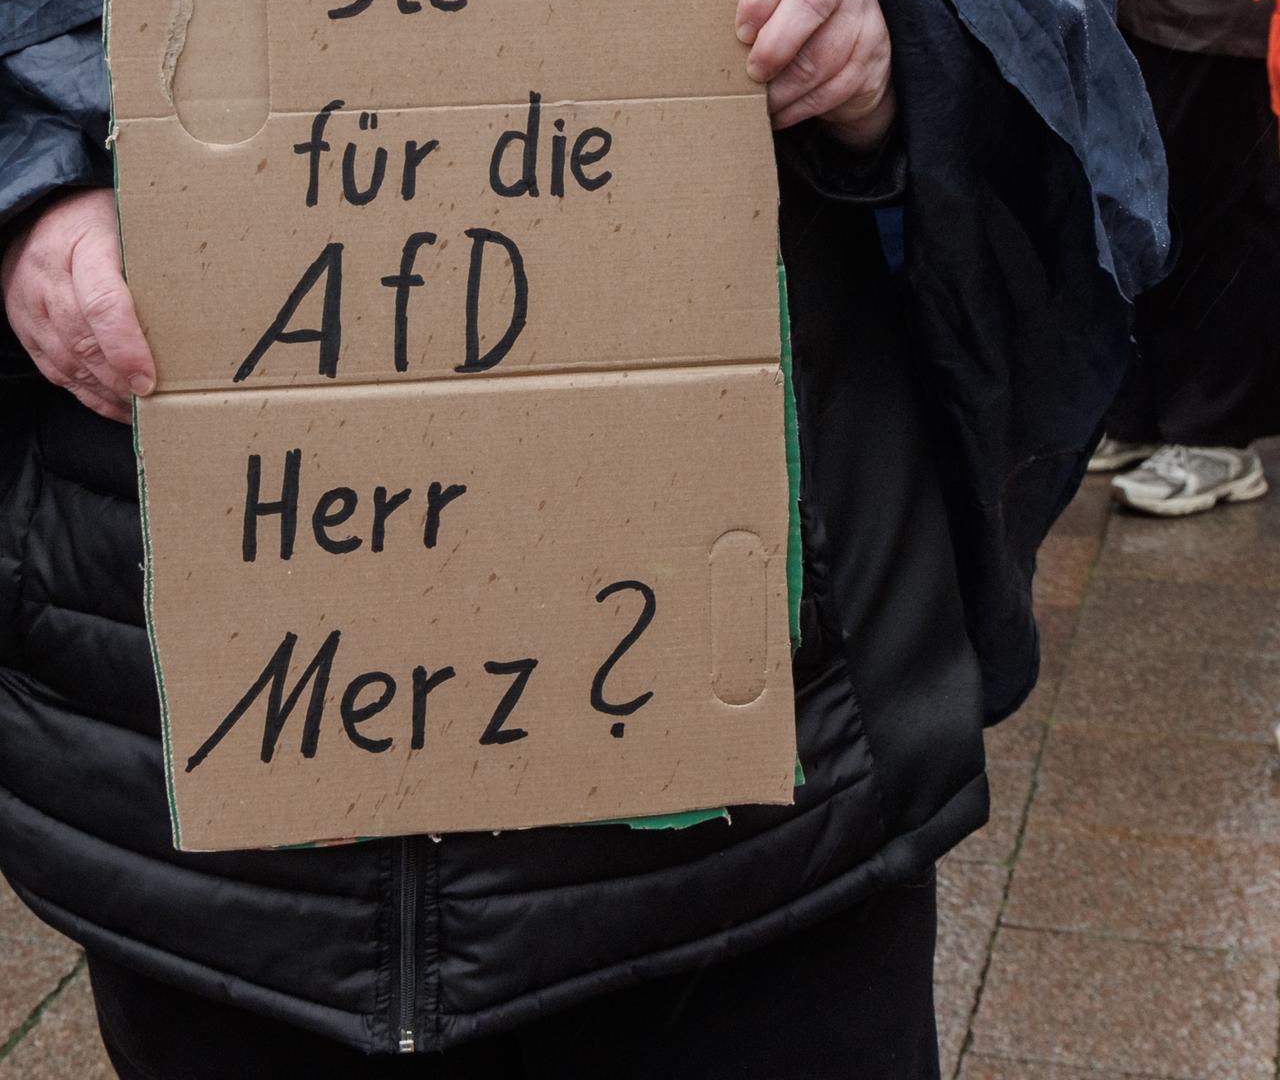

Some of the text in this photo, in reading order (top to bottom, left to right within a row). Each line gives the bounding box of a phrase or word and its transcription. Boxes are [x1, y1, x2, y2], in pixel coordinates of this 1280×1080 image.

[294, 90, 613, 208] für die
[232, 227, 529, 383] AfD
[242, 448, 467, 563] Herr
